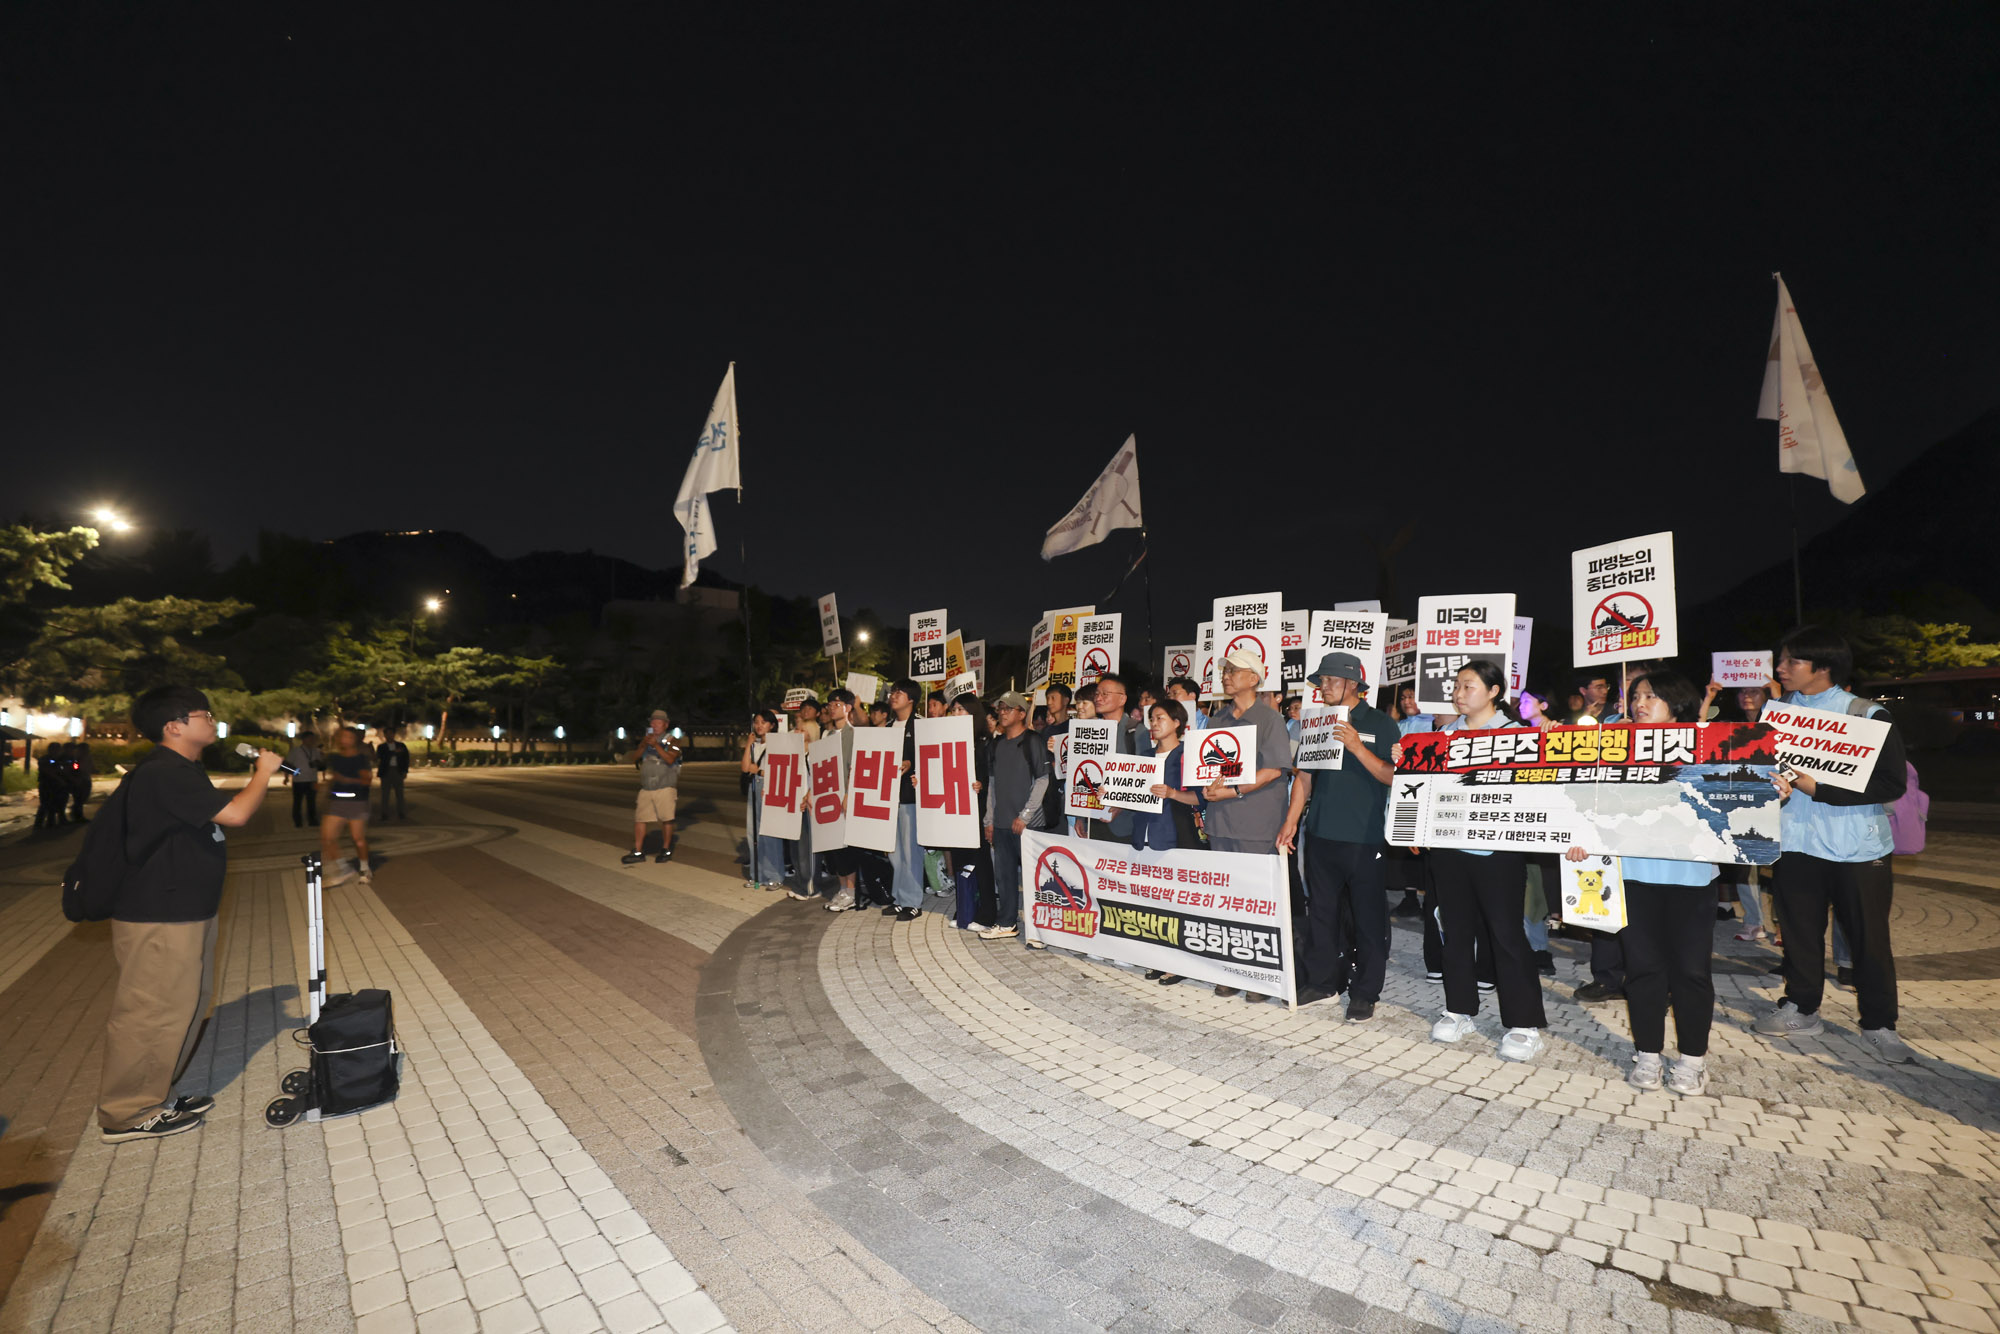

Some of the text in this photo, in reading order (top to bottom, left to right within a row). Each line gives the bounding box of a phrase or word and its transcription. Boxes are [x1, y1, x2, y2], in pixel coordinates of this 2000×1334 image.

[1588, 548, 1652, 574] 파병논의
[1586, 567, 1655, 592] 중단하라!
[1224, 603, 1268, 617] 침략전쟁
[1437, 607, 1487, 624] 미국의
[917, 618, 938, 629] 정부는
[1083, 620, 1114, 632] 굴종외교
[1224, 618, 1268, 632] 가담하는
[1323, 619, 1374, 635] 침략전쟁
[913, 629, 942, 642] 파병 요구
[1082, 633, 1114, 645] 중단하라!
[1390, 629, 1414, 643] 미국의
[1426, 628, 1502, 646] 파병 압박
[1590, 626, 1621, 637] 호르무즈
[1321, 635, 1372, 650] 가담하는
[1591, 628, 1656, 653] 파병반대
[913, 646, 931, 662] 거부
[1384, 643, 1401, 654] 파병
[919, 657, 942, 674] 하라!
[1281, 664, 1303, 679] 라!
[1425, 655, 1471, 679] 규탄
[1721, 672, 1762, 682] 추방하라!
[1302, 714, 1338, 730] DO NOT JOIN
[1765, 710, 1848, 735] NO NAVAL
[1075, 727, 1109, 740] 파병논의
[1300, 732, 1329, 746] A WAR OF
[1073, 742, 1109, 755] 중단하라!
[1447, 728, 1695, 768] 호르무즈 전쟁행 티켓
[1777, 731, 1876, 759] PLOYMENT
[1299, 749, 1340, 763] AGGRESSION!
[1779, 751, 1858, 776] HORMUZ!
[1105, 762, 1156, 774] DO NOT JOIN
[1198, 762, 1242, 777] 파병반대
[1475, 766, 1661, 783] 국민을 전쟁터로 보내는 티켓
[765, 753, 802, 813] 파
[853, 750, 899, 821] 반
[919, 741, 971, 815] 대
[1103, 777, 1146, 788] A WAR OF
[812, 755, 841, 825] 병
[1708, 793, 1738, 801] 호르무즈
[1103, 792, 1160, 805] AGGRESSION!
[1470, 793, 1513, 804] 대한민국
[1468, 811, 1510, 822] 호르무즈
[1513, 812, 1547, 823] 전쟁터
[1467, 829, 1496, 840] 한국군
[1505, 830, 1547, 841] 대한민국
[1549, 832, 1571, 843] 국민
[1095, 858, 1230, 888] 미국은 침략전쟁 중단하라!
[1097, 877, 1277, 917] 정부는 파병압박 단호히 거부하라!
[1036, 905, 1094, 935] 파병반대
[1101, 903, 1280, 965] 파병반대 평화행진
